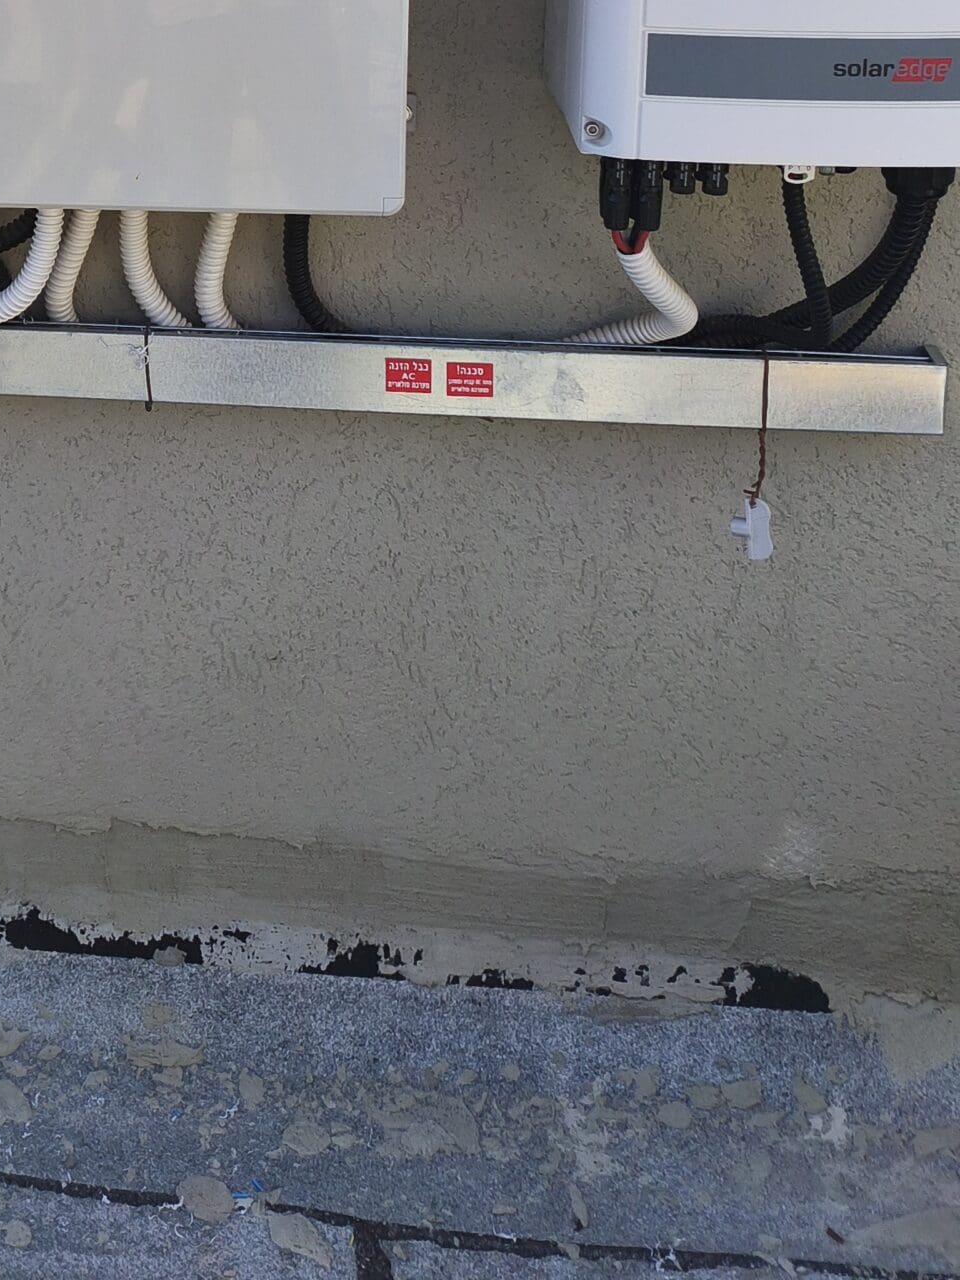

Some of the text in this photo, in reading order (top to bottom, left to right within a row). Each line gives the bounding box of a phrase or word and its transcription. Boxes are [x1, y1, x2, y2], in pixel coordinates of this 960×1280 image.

[833, 58, 949, 81] solaredge
[388, 361, 429, 372] כבל הזנה
[456, 364, 484, 376] סכנה!
[401, 372, 416, 380] AC
